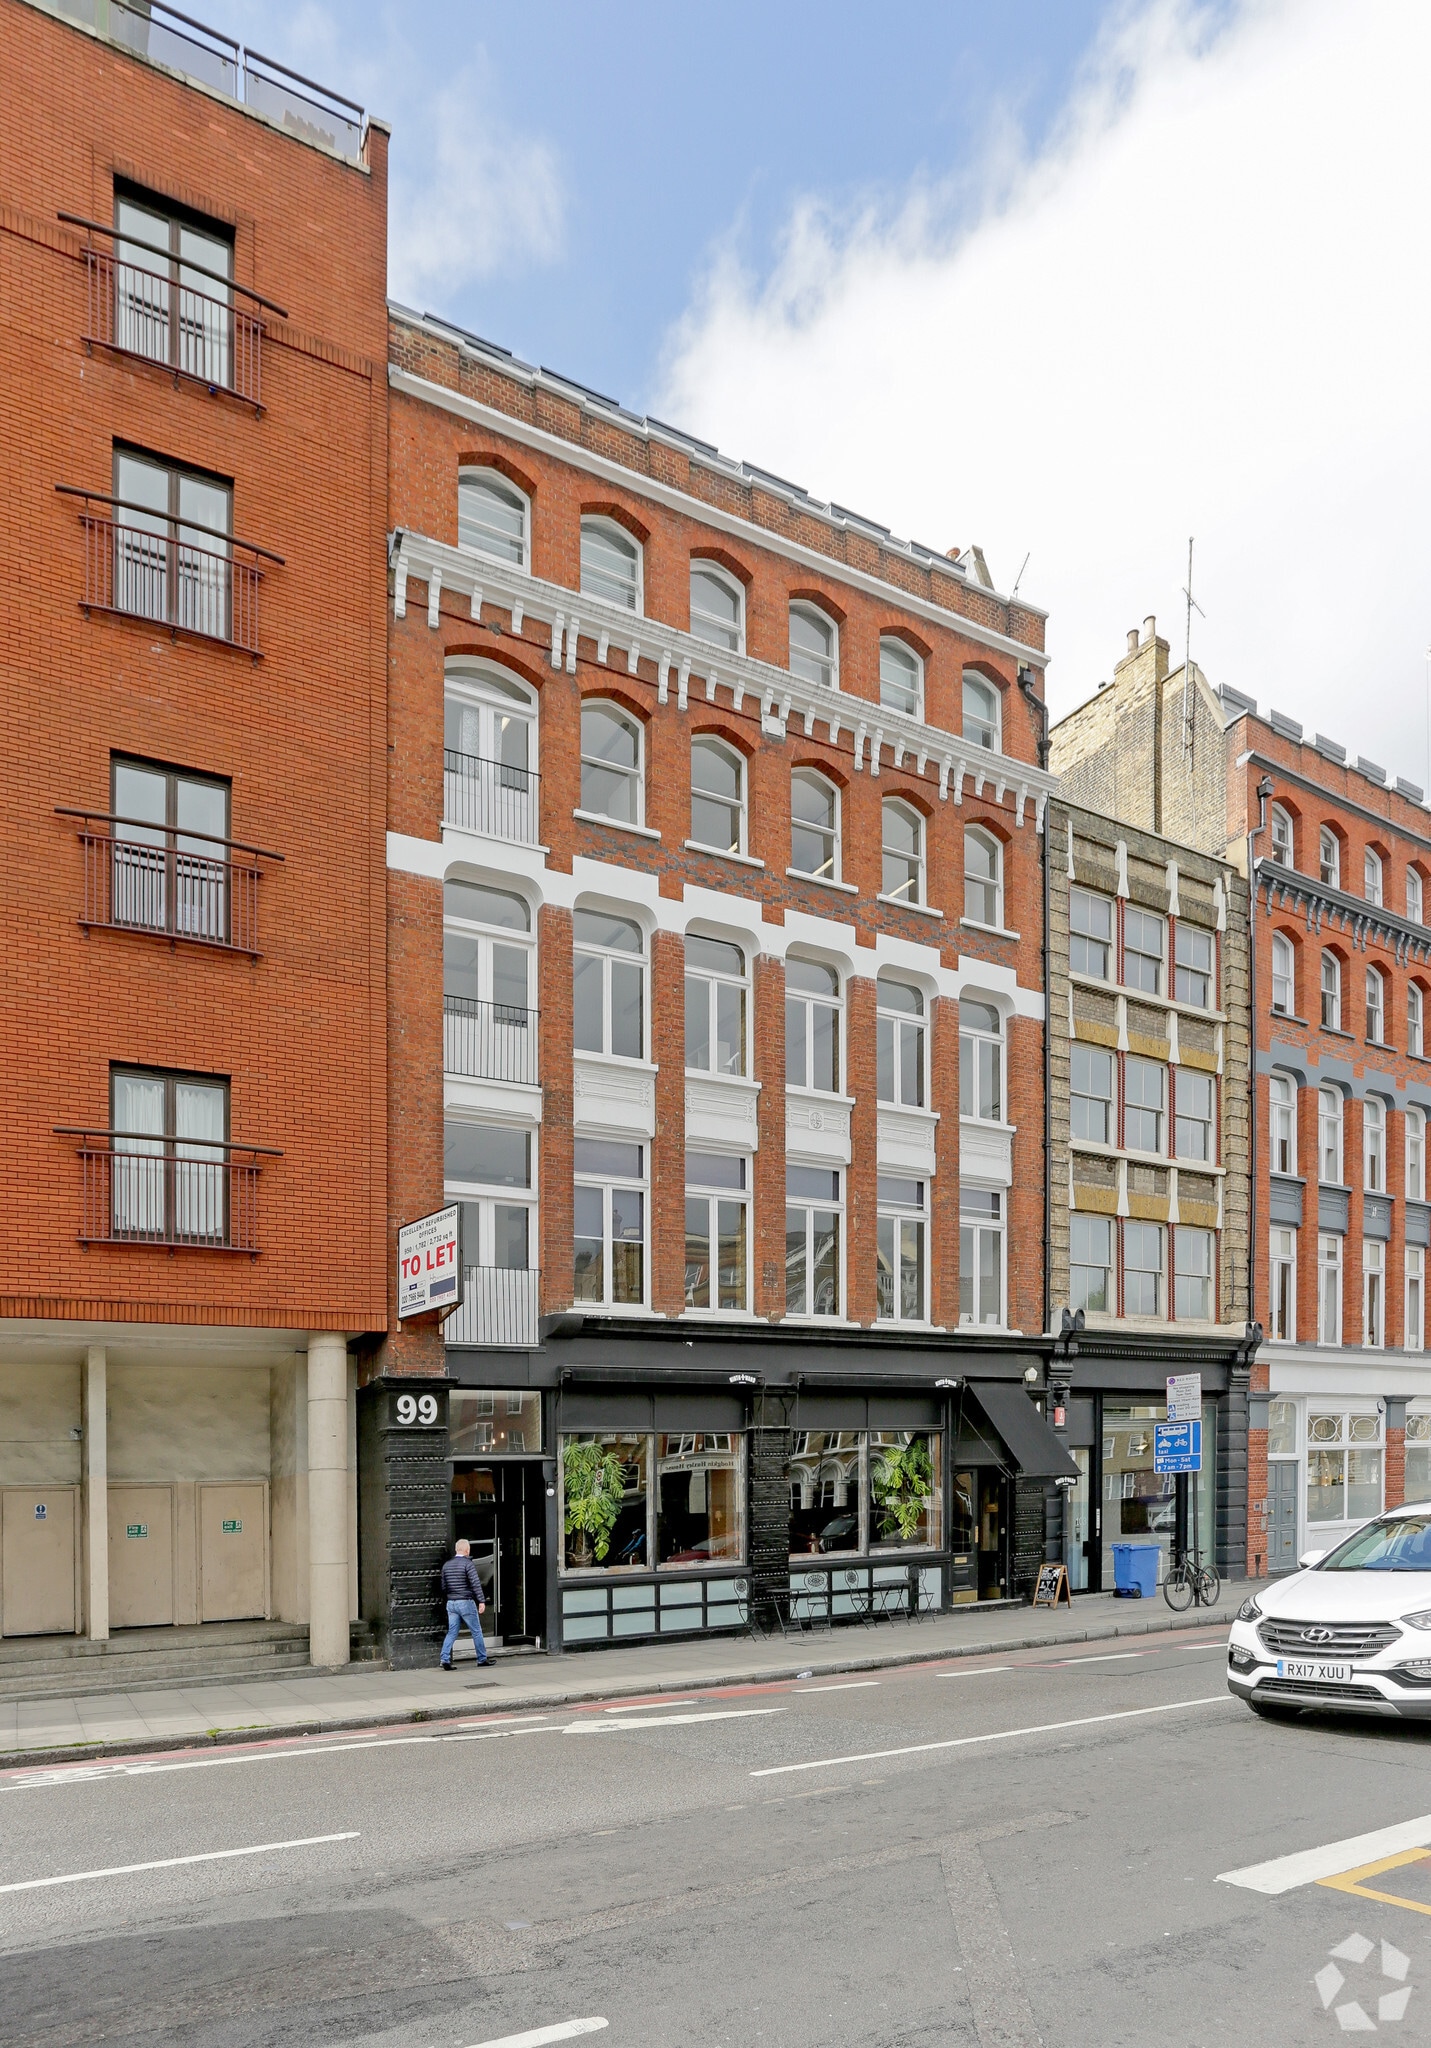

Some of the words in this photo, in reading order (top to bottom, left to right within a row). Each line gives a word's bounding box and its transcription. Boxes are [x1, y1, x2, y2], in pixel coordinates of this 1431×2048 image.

[401, 1222, 424, 1238] EXCELLENT
[426, 1210, 456, 1227] REFURBISHED
[418, 1226, 437, 1238] OFFICES
[401, 1255, 421, 1280] TO
[426, 1240, 456, 1271] LET
[397, 1395, 438, 1424] 99
[1288, 1664, 1314, 1676] RX17
[1319, 1666, 1344, 1679] XUU
